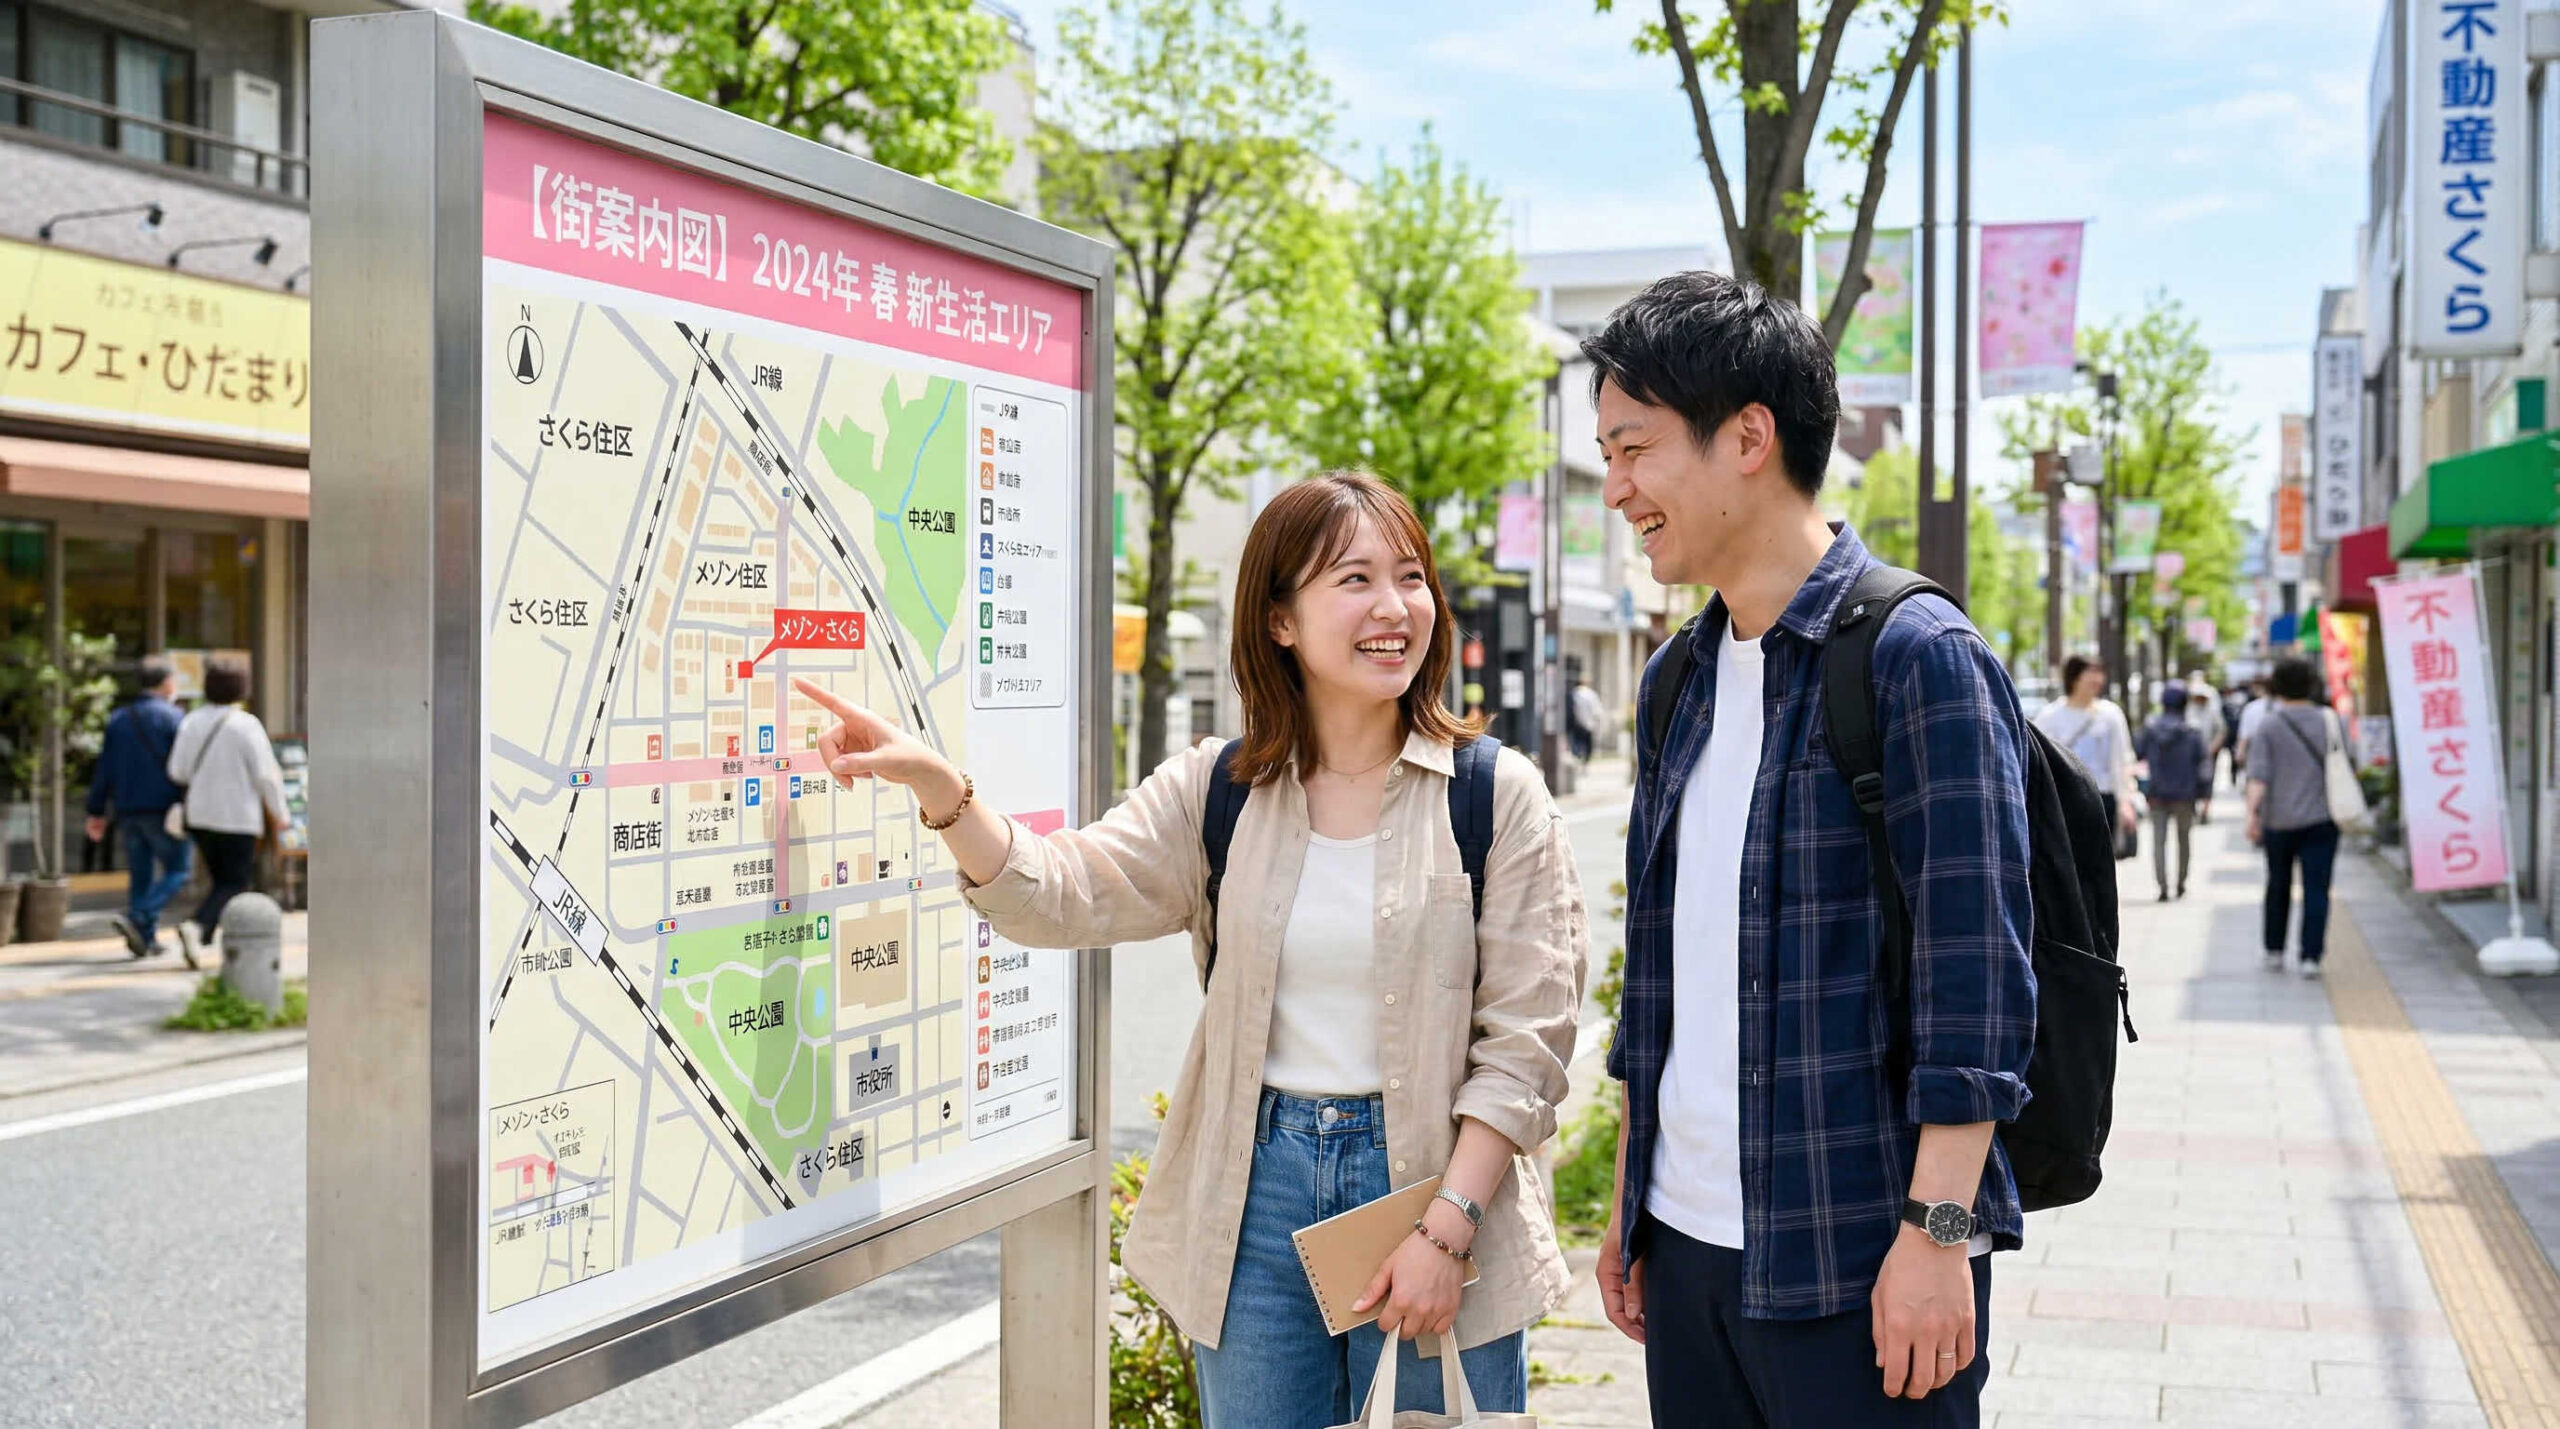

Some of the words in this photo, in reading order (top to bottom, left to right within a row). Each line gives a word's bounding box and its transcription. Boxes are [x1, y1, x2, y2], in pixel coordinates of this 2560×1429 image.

[2440, 1, 2497, 335] 不動産さくら
[533, 164, 727, 283] 【街案内図】
[752, 232, 862, 313] 2024年
[870, 262, 899, 323] 春
[906, 271, 1052, 355] 新生活エリア
[521, 303, 531, 322] N
[6, 313, 308, 409] カフェ・ひだまり
[538, 413, 634, 457] さくら住区
[695, 561, 768, 589] メゾン住区
[508, 598, 589, 627] さくら住区
[779, 616, 861, 643] メゾン・さくら
[2405, 589, 2481, 873] 不動産さくら
[613, 820, 663, 852] 商店街
[856, 1064, 893, 1098] 市役所
[500, 1101, 570, 1135] メゾン・さくら
[800, 1137, 864, 1179] さくら住区
